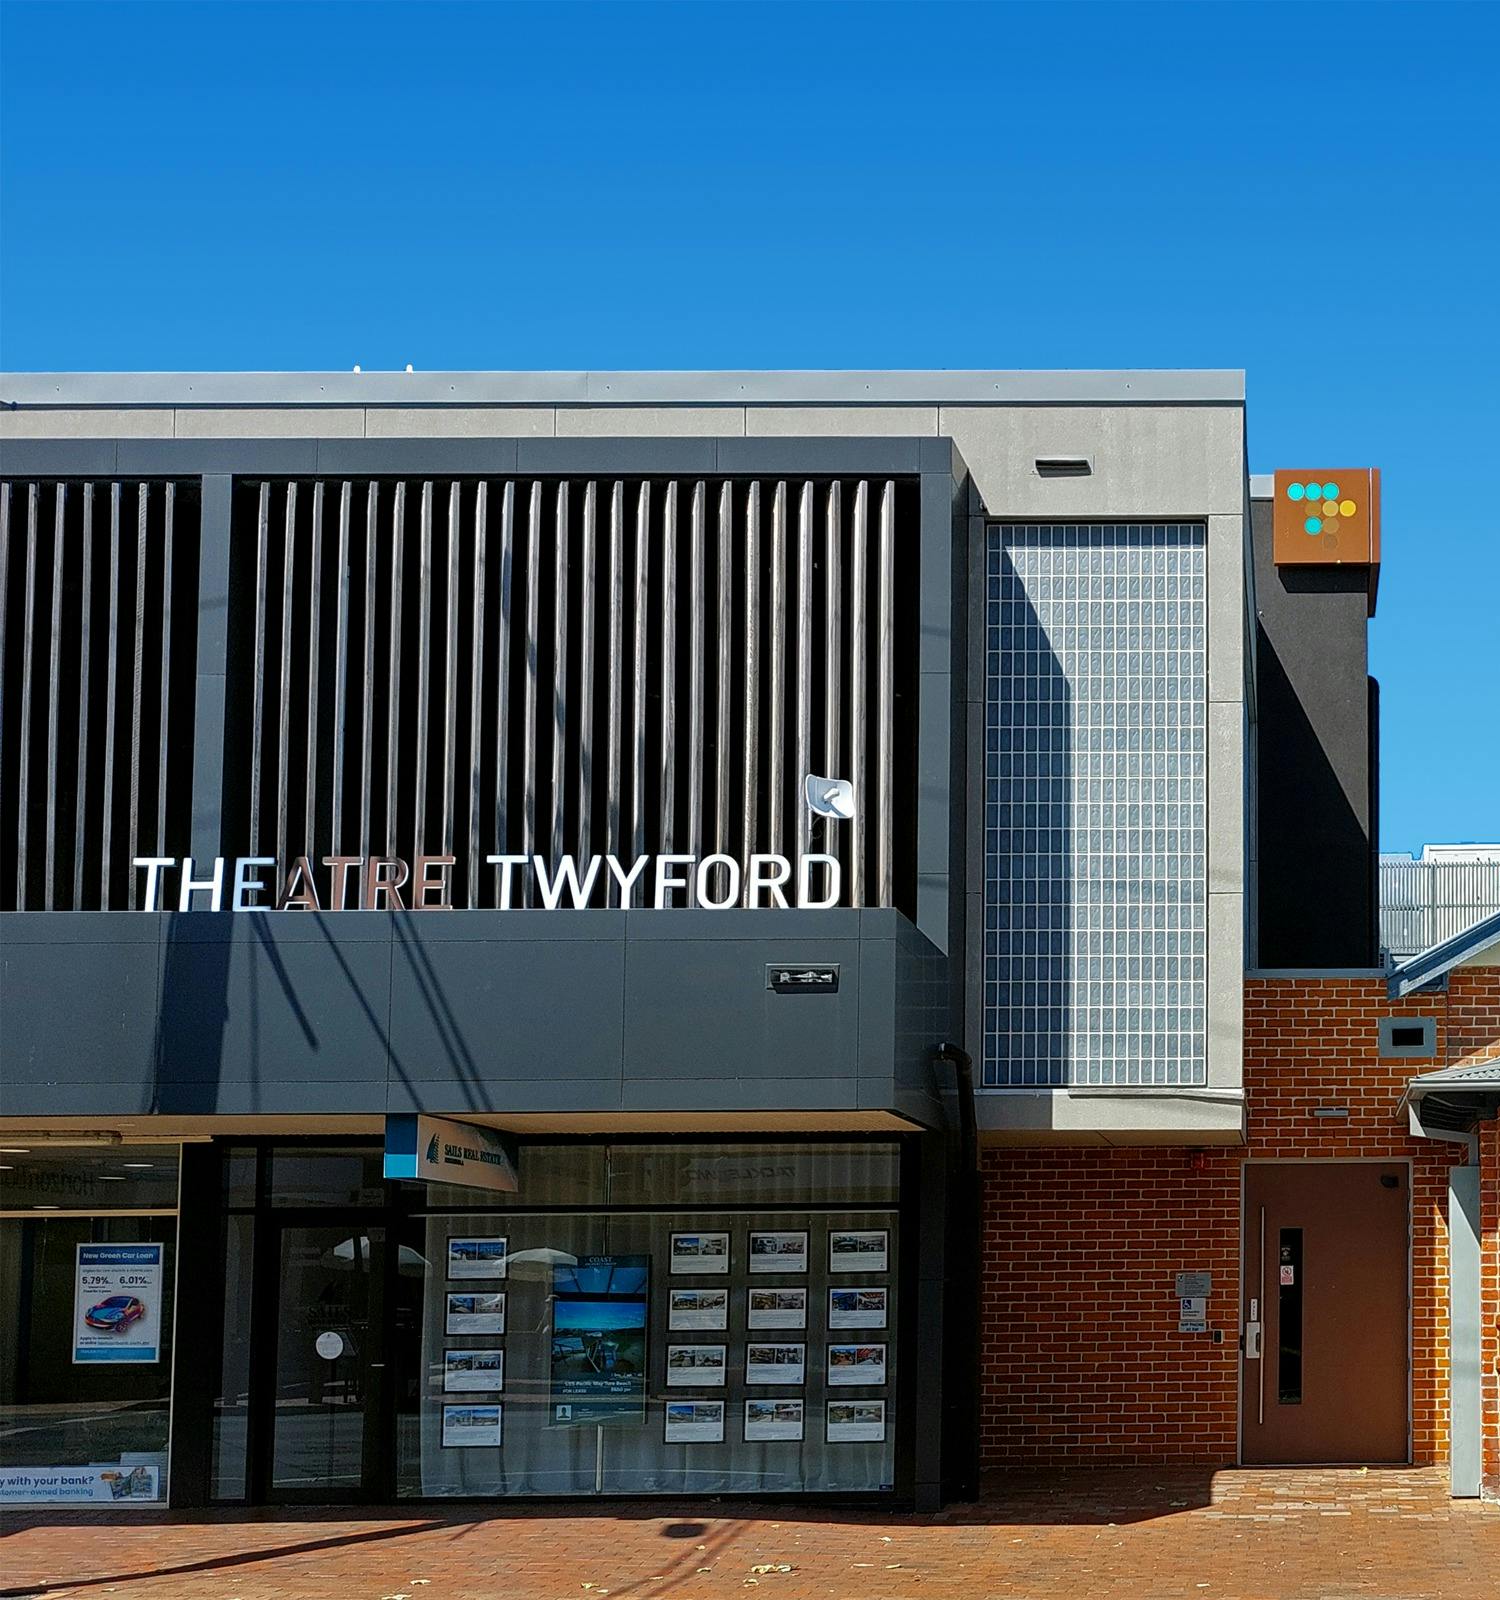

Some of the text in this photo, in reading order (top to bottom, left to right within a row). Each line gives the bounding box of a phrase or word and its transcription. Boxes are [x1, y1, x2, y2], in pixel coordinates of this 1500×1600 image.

[133, 854, 842, 911] THEATRE TWYFORD
[8, 1476, 31, 1485] with
[33, 1477, 58, 1487] your
[61, 1475, 95, 1485] bank?
[59, 1487, 93, 1497] banking
